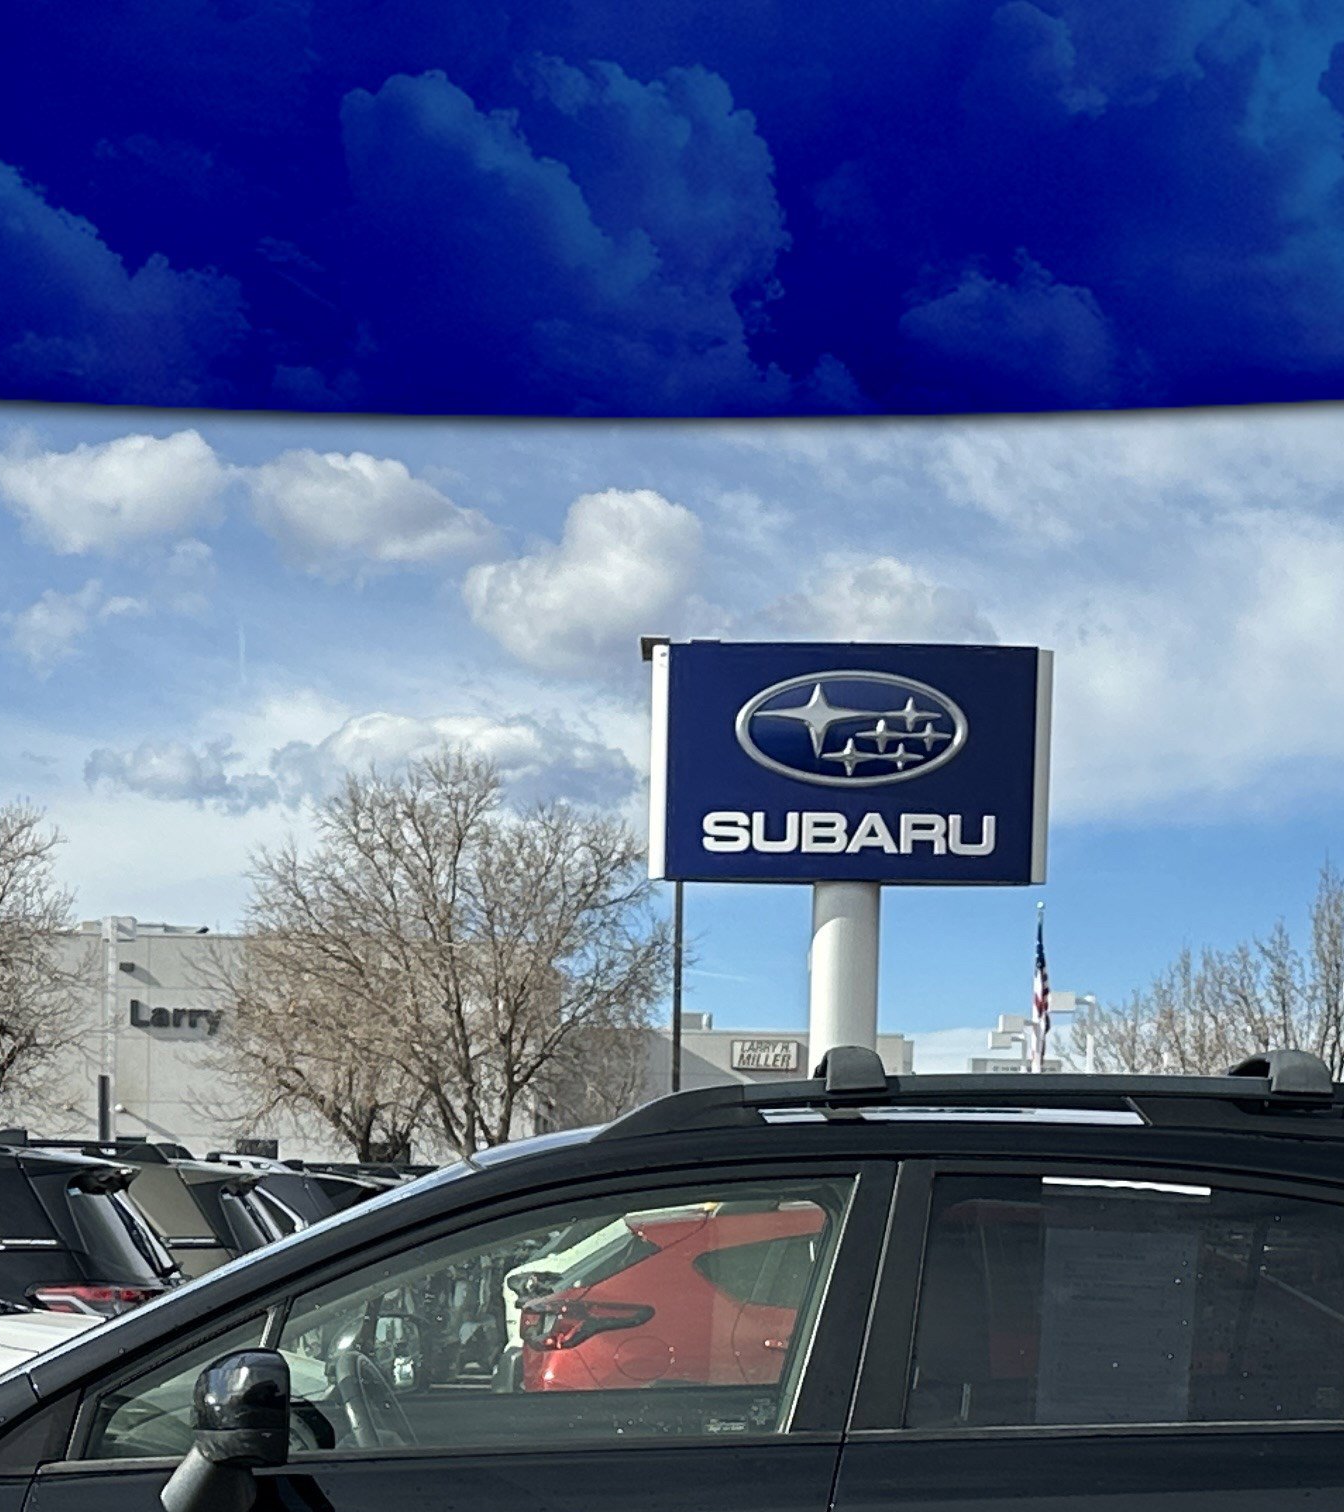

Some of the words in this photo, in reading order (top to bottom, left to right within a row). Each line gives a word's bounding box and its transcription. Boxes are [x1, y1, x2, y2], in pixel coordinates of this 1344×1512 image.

[702, 811, 996, 855] SUBARU
[130, 999, 225, 1036] Larry
[738, 1053, 792, 1068] MILLER
